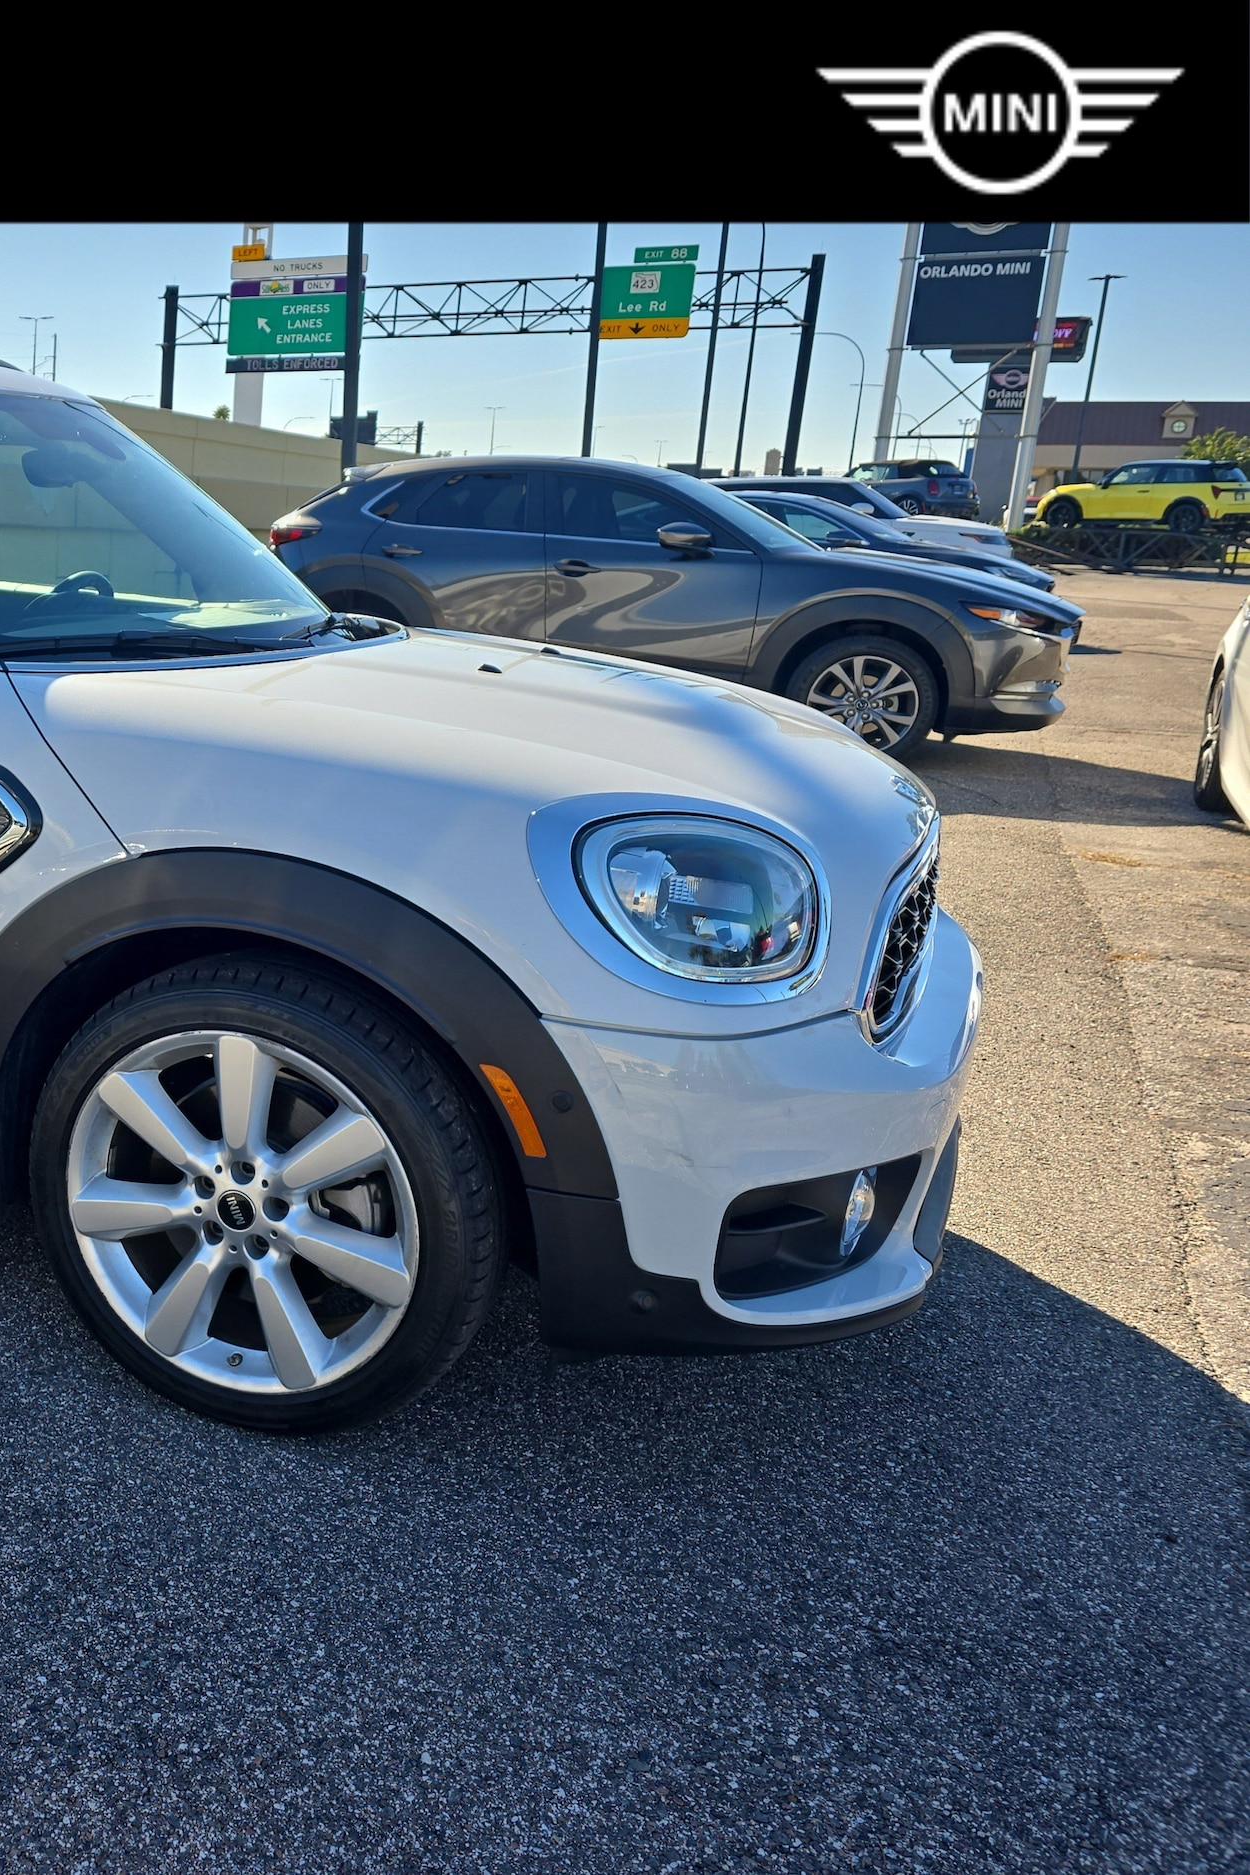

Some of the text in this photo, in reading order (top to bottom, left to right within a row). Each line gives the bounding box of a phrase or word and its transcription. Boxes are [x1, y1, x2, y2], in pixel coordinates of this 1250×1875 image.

[238, 248, 258, 257] LEFT
[644, 248, 688, 259] EXIT 88
[273, 261, 324, 272] NO TRUCKS
[920, 261, 1032, 279] ORLANDO MINI
[307, 281, 331, 291] ONLY
[632, 279, 655, 289] 423
[281, 303, 331, 315] EXPRESS
[618, 300, 667, 313] Lee Rd
[287, 318, 323, 329] LANES
[600, 324, 681, 334] EXIT ONLY
[276, 332, 333, 344] ENTRANCE
[246, 357, 339, 371] TOLLS ENFORCED
[987, 389, 1027, 399] Orland
[995, 398, 1024, 408] MINI
[226, 1196, 246, 1226] MINI
